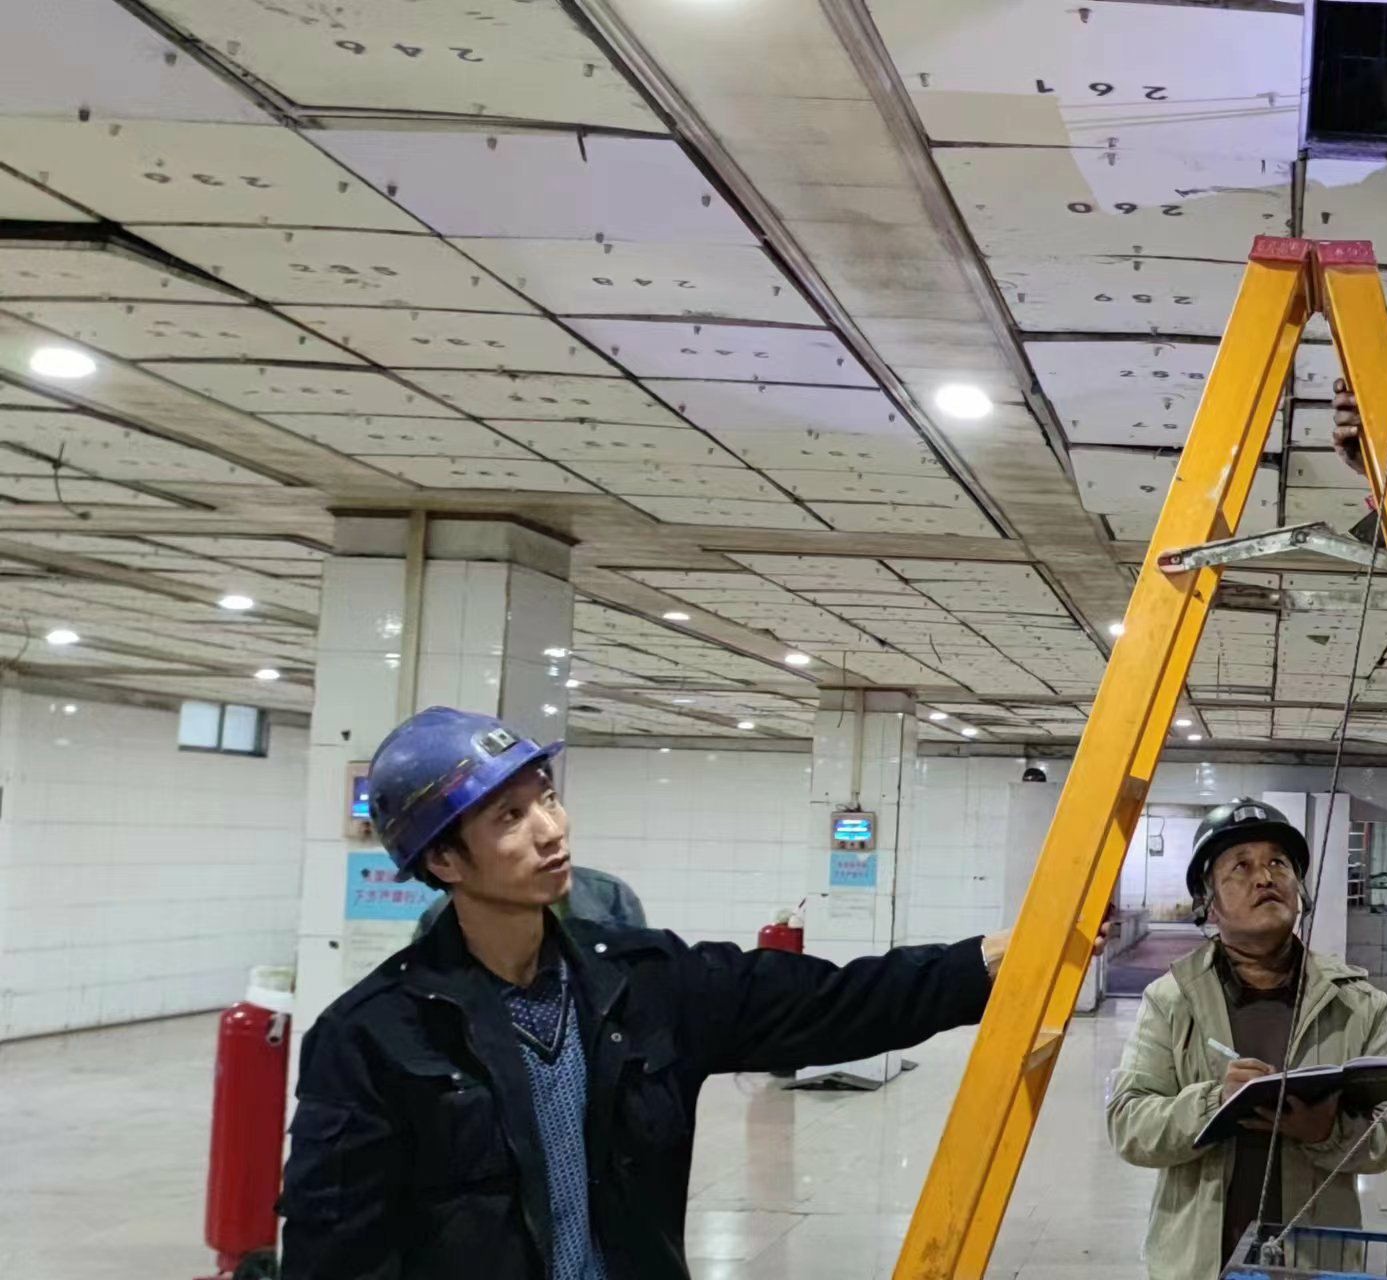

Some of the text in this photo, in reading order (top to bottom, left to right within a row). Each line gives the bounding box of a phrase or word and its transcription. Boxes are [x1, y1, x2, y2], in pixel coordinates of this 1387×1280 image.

[1035, 79, 1169, 101] 261
[1066, 202, 1185, 217] 260
[1093, 293, 1193, 305] 259
[1119, 370, 1206, 380] 258
